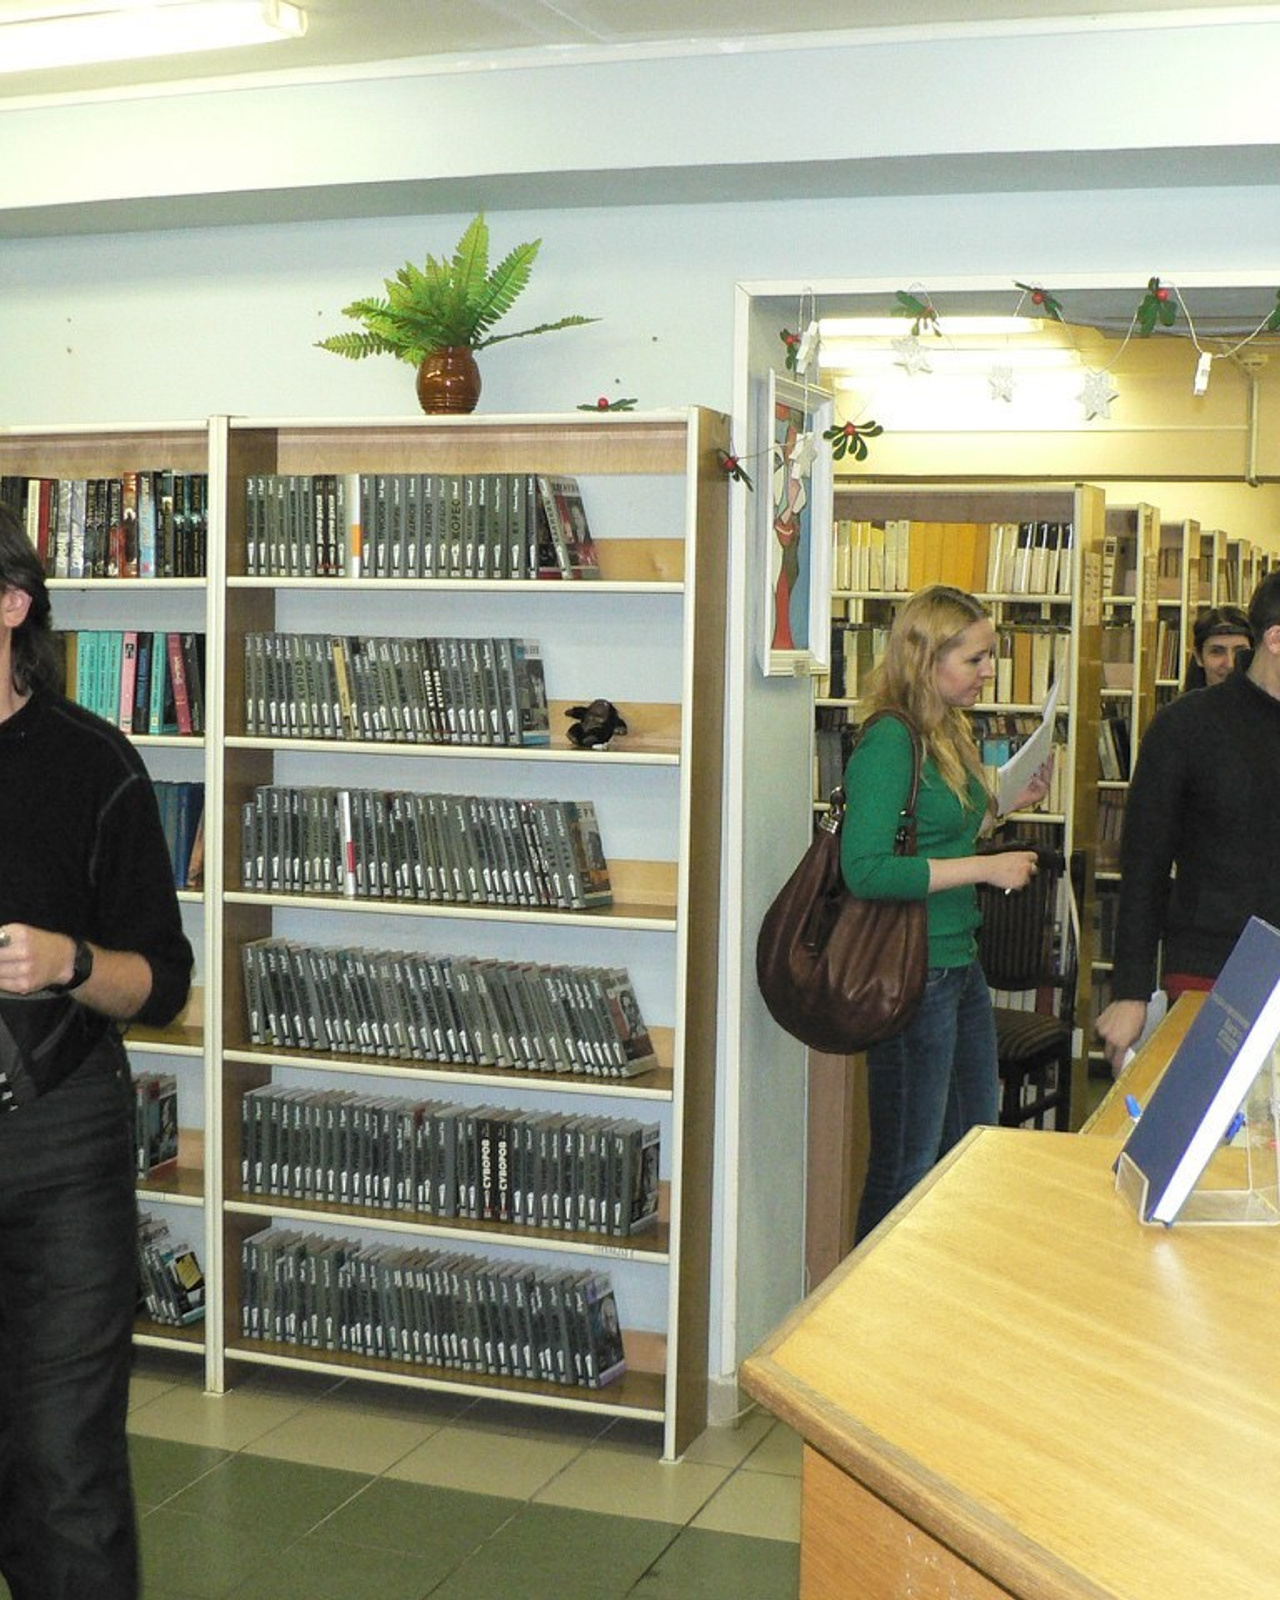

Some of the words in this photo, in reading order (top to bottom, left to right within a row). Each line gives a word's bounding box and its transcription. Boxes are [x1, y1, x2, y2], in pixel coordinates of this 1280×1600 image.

[451, 499, 461, 542] ЖОРЕС
[295, 659, 305, 699] КИРОВ
[481, 1139, 491, 1190] СУВОРОВ
[499, 1141, 508, 1191] СУВОРОВ
